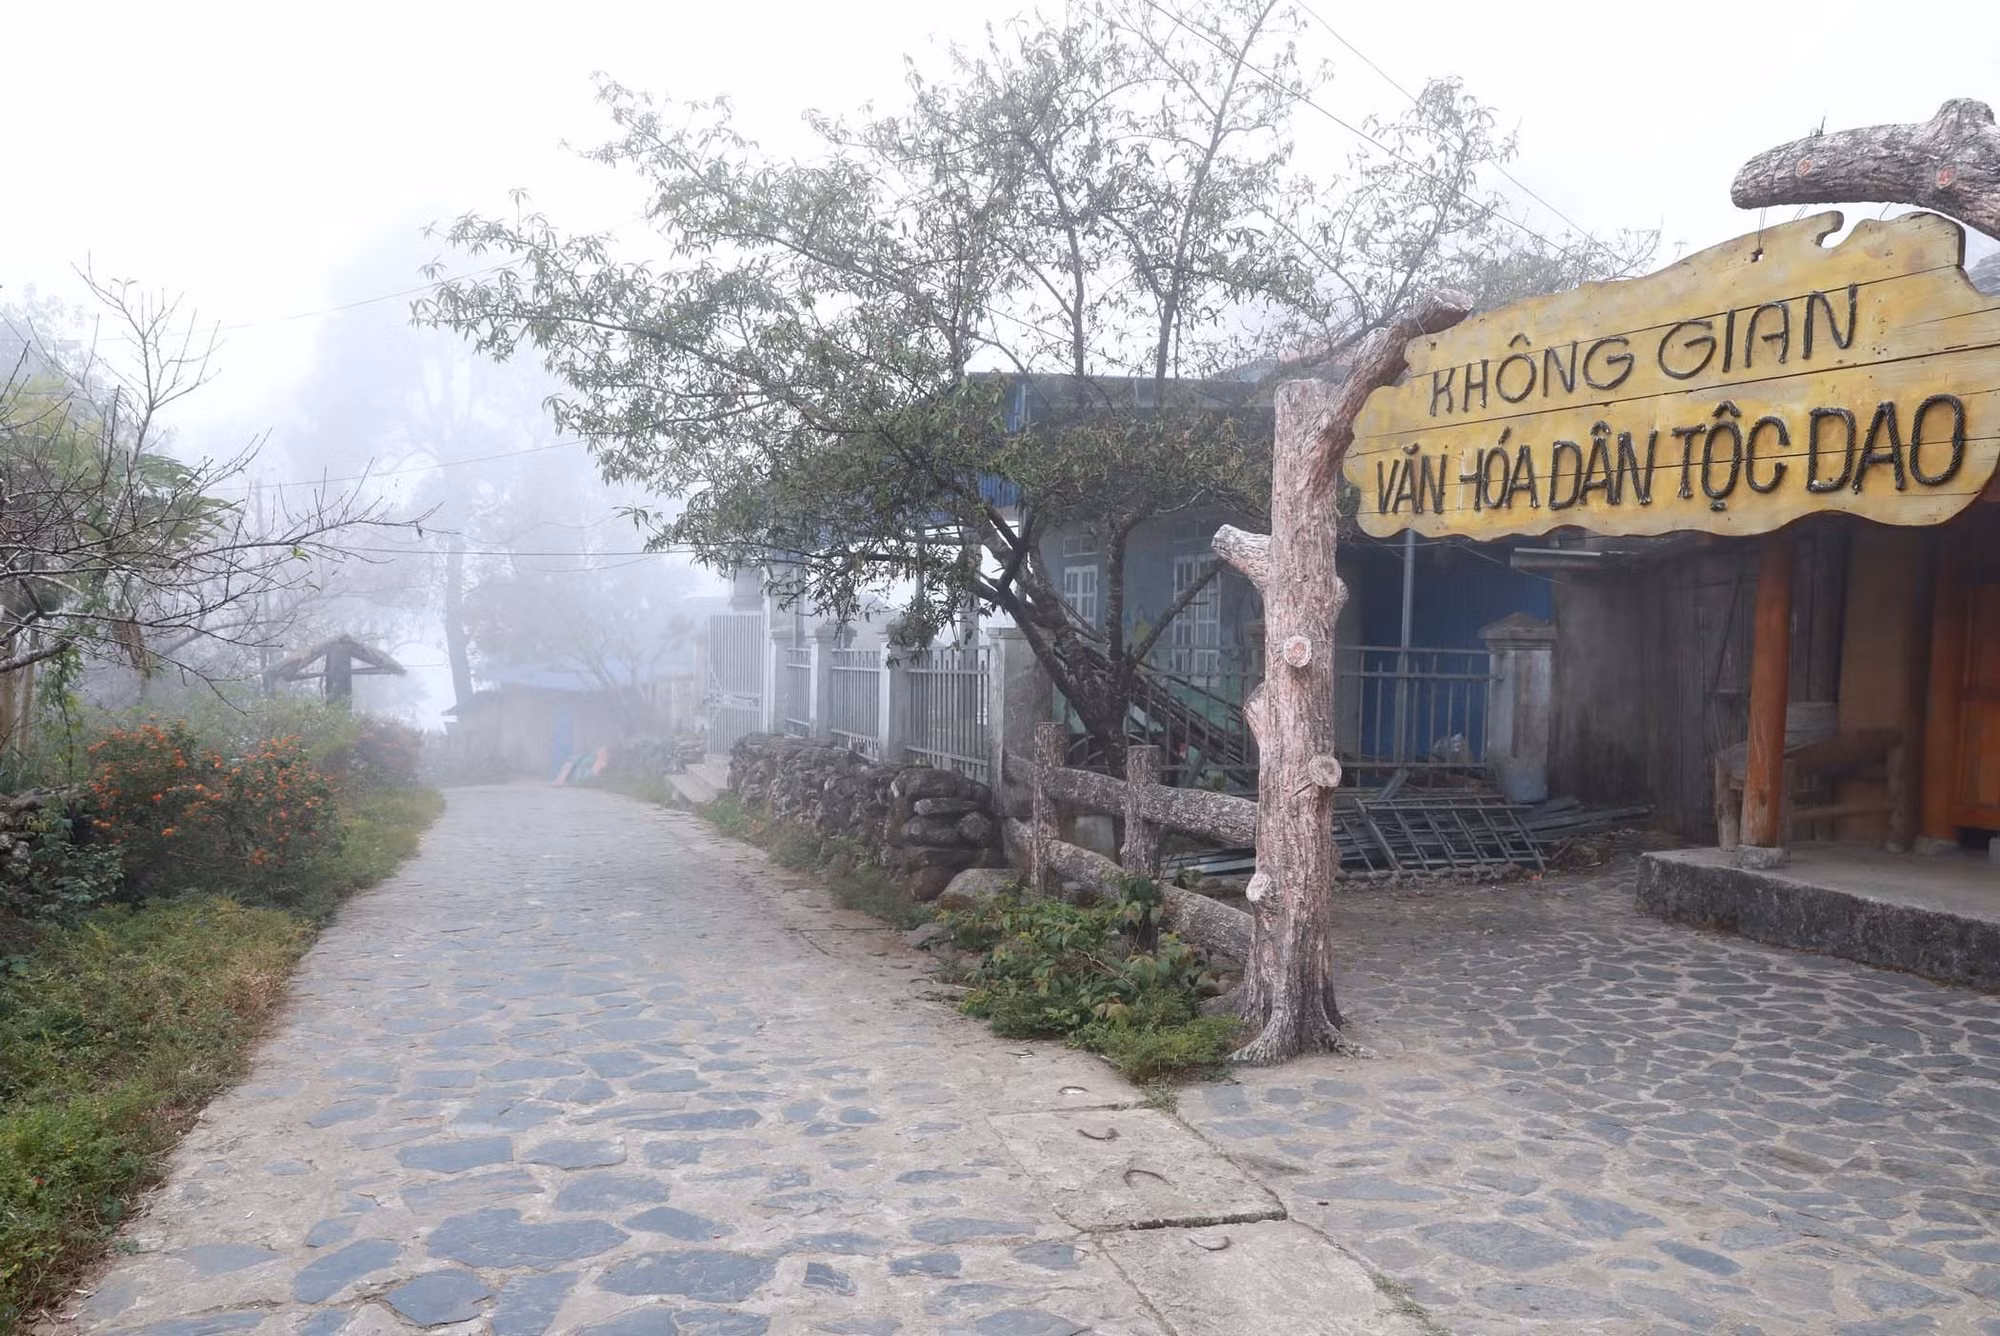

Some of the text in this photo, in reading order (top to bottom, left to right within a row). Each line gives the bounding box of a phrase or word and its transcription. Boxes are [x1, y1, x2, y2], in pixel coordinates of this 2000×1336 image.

[1429, 283, 1859, 417] KHÔNG GIAN
[1377, 393, 1966, 514] VĂN HÓA DÂN TỘC DAO
